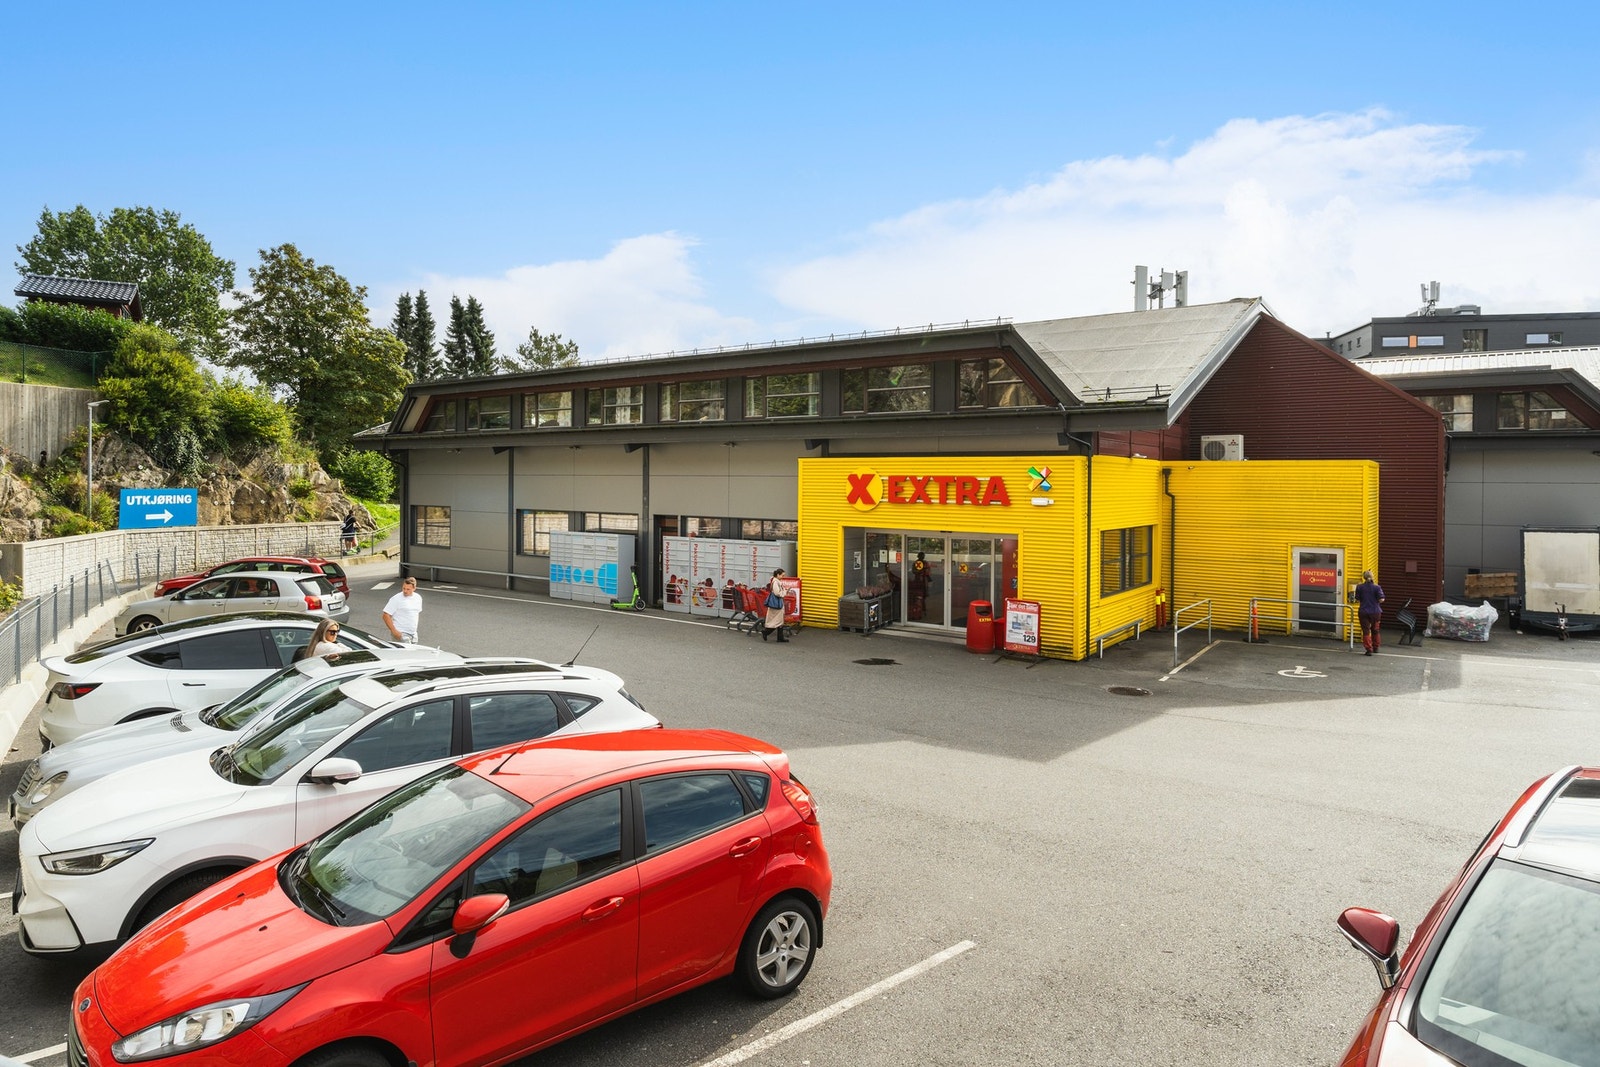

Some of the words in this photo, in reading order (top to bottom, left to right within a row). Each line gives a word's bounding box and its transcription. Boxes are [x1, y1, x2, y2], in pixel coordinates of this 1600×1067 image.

[887, 476, 1011, 505] EXTRA
[126, 494, 192, 506] UTKJØRING
[1023, 634, 1036, 644] 129
